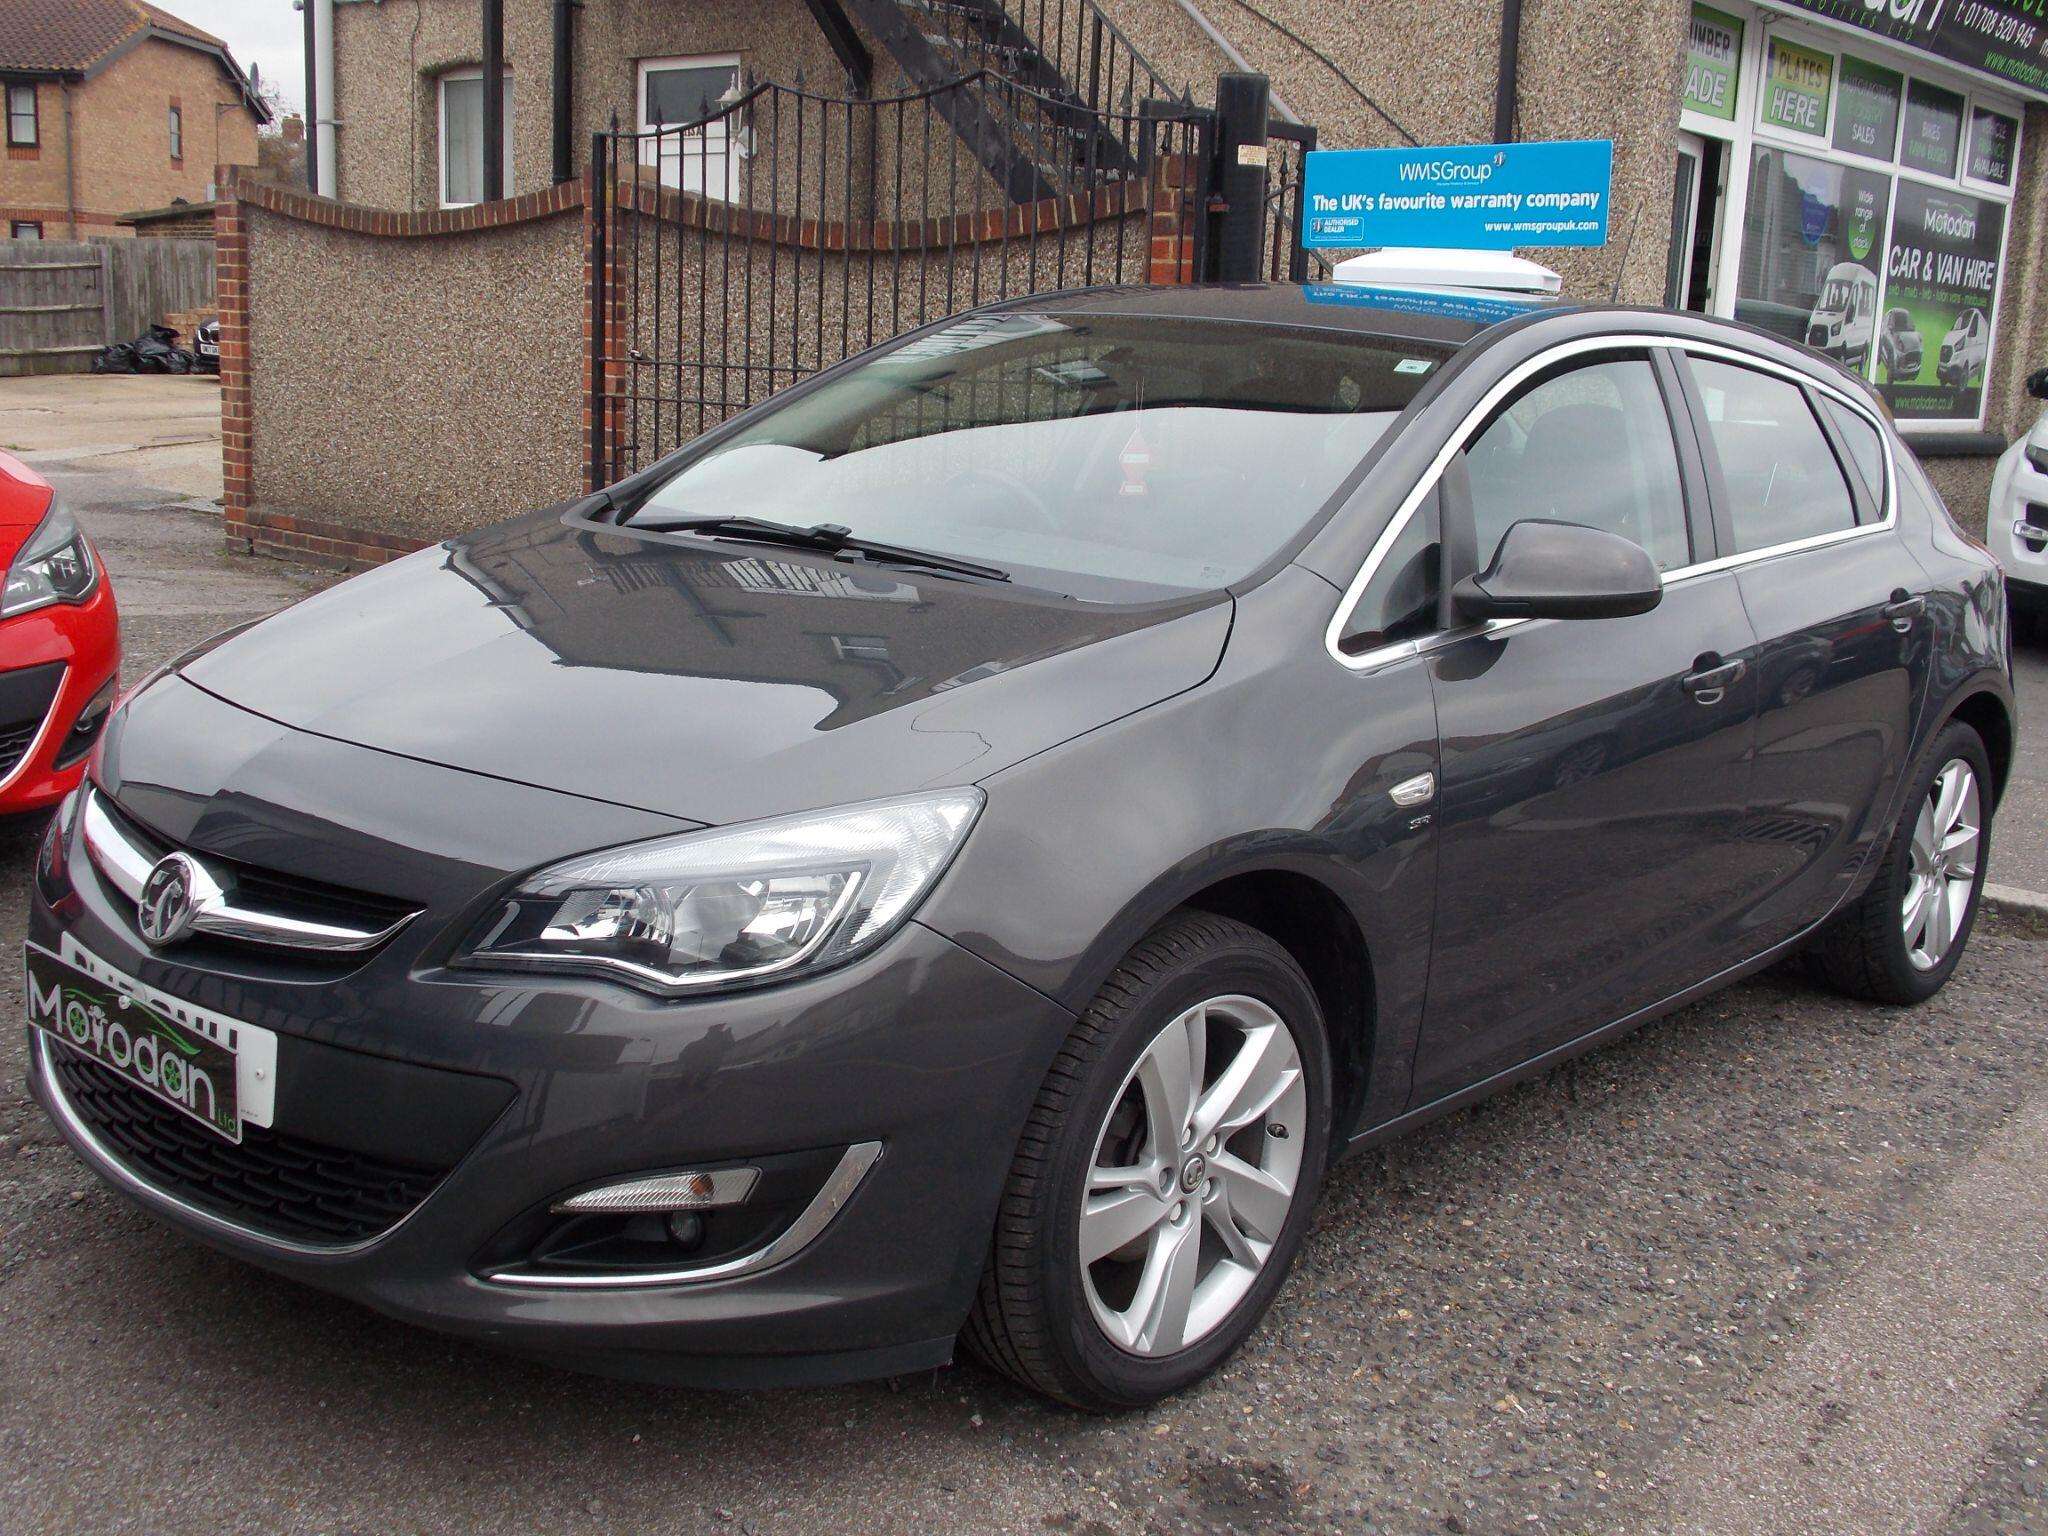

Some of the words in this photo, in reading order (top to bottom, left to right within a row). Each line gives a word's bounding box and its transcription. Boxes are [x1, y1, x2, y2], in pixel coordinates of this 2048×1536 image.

[1963, 2, 1999, 34] 01708
[1995, 15, 2018, 42] 520
[1778, 51, 1824, 88] PLATES
[1770, 86, 1821, 129] HERE
[1399, 160, 1492, 184] WMSGroup
[1312, 195, 1338, 212] The
[1341, 194, 1374, 211] UK's
[1378, 192, 1445, 210] favourite
[1450, 192, 1521, 212] warranty
[1526, 191, 1600, 211] company
[1484, 220, 1599, 234] www.wmsgroupuk.com
[1924, 208, 1976, 240] Motodan
[1889, 245, 1921, 279] CAR
[1923, 251, 1933, 281] &
[1937, 253, 1964, 286] VAN
[1963, 258, 1995, 290] HIRE
[29, 970, 215, 1120] Motodan
